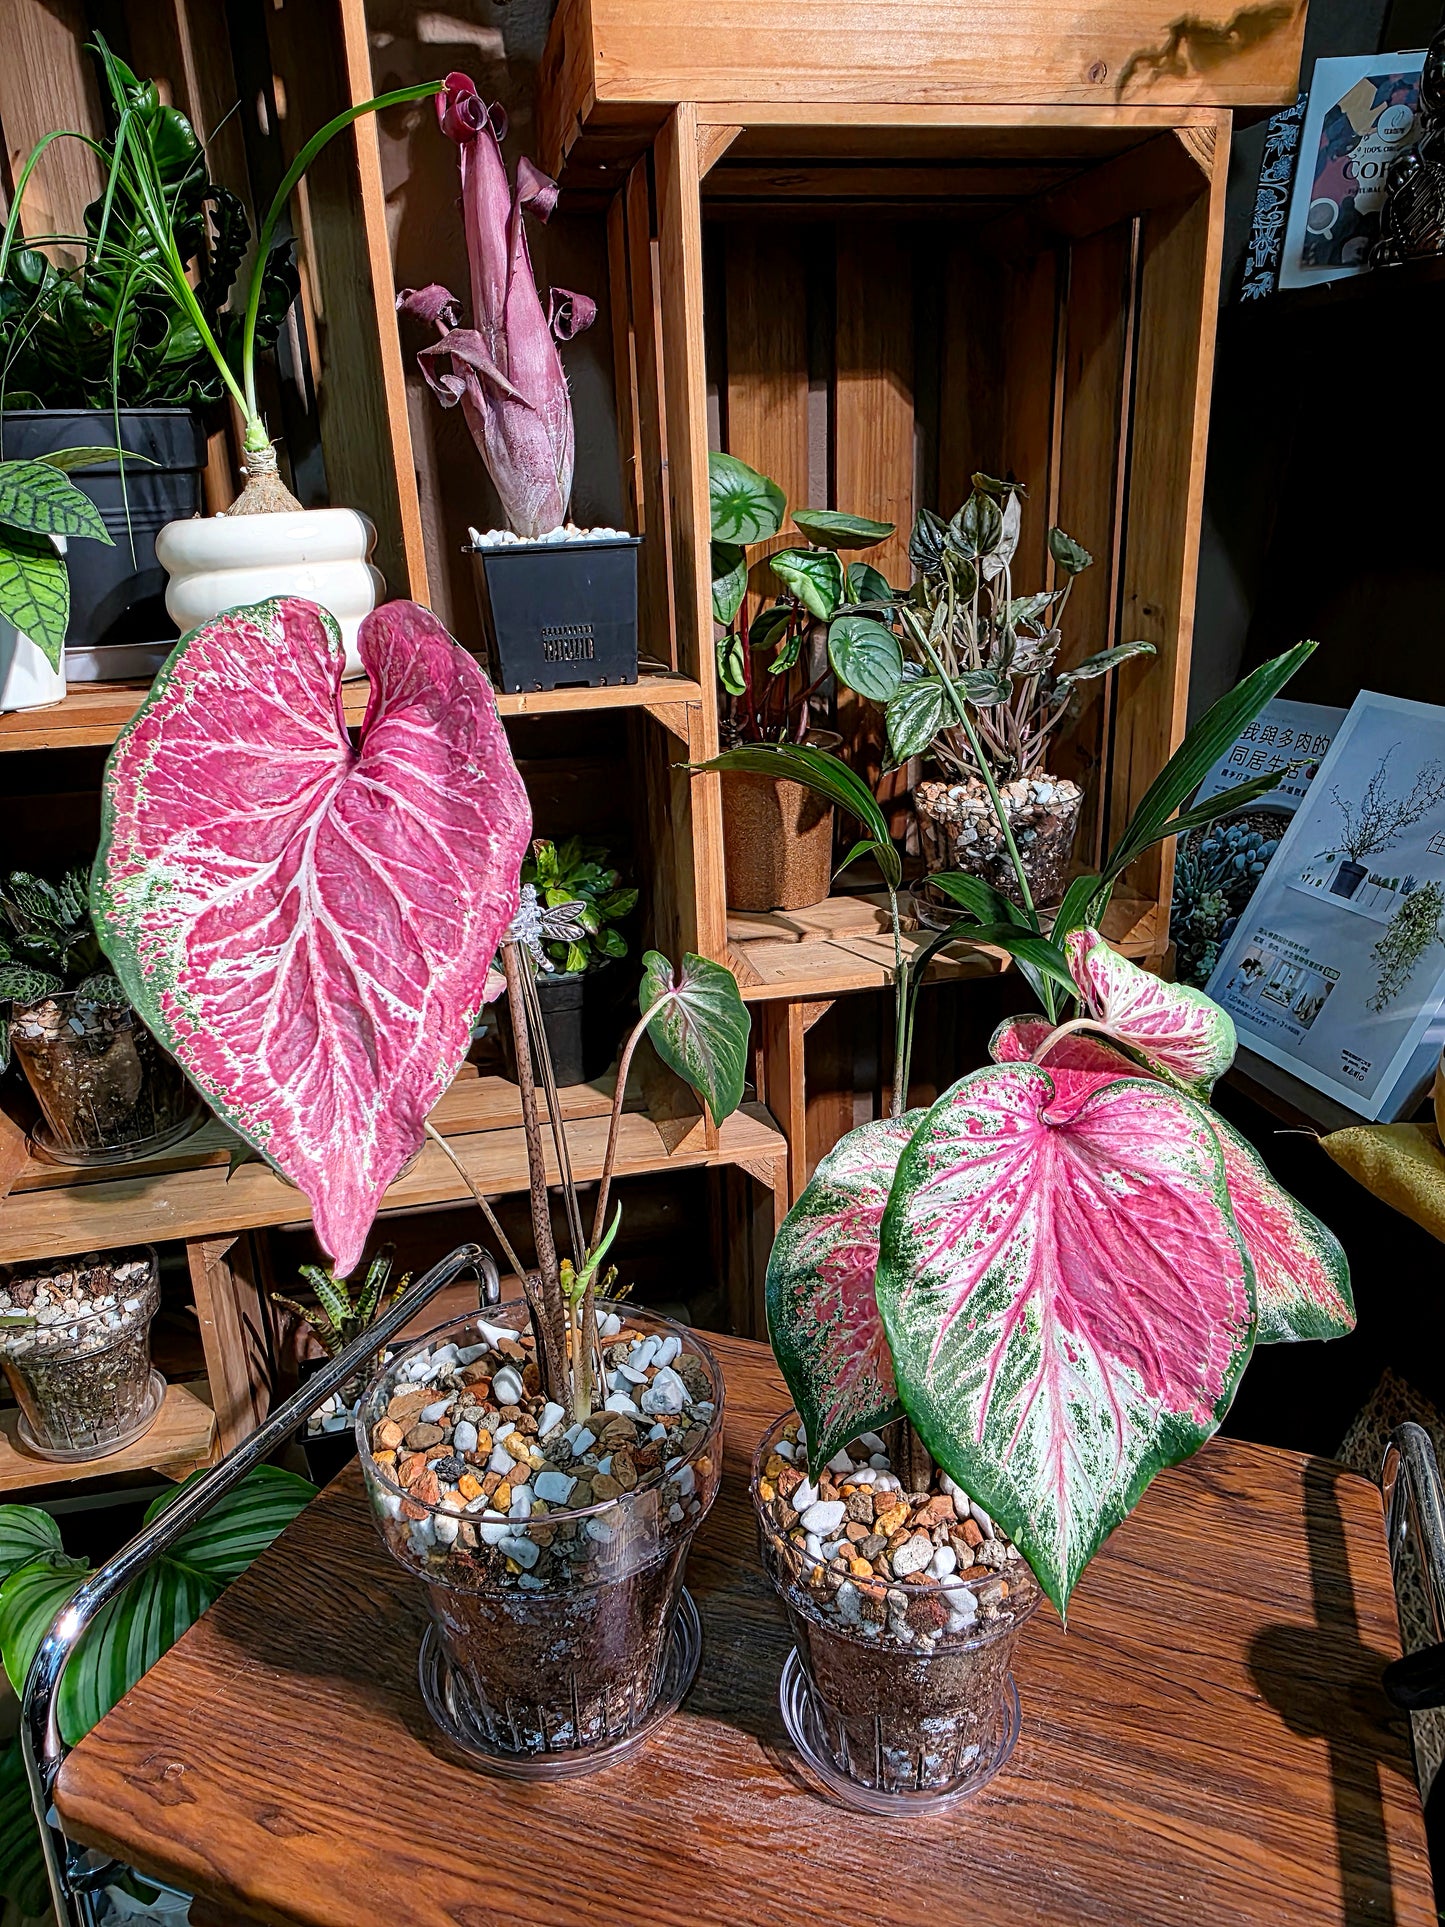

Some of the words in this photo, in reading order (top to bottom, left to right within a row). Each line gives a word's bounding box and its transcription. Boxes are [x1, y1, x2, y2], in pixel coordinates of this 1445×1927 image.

[1240, 721, 1331, 757] 我與多肉的
[1228, 745, 1304, 780] 同居生活
